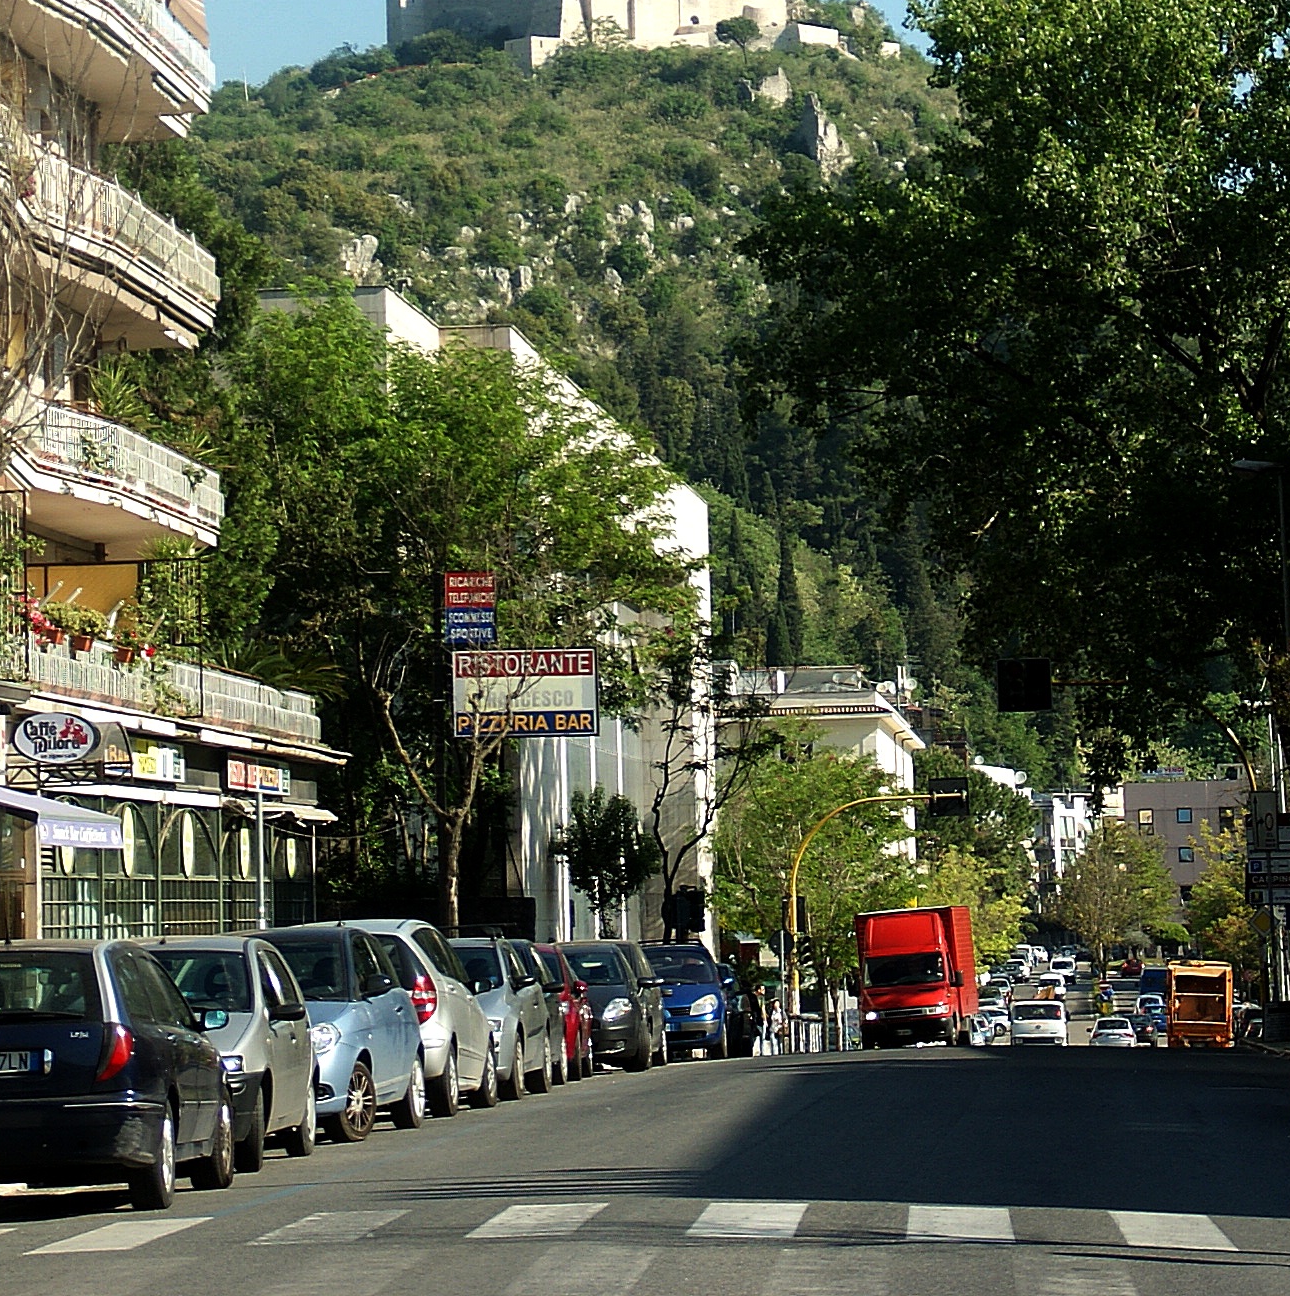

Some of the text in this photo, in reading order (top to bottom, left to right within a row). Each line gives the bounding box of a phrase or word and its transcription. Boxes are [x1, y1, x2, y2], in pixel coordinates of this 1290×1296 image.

[456, 653, 590, 675] RISTORANTE
[456, 714, 591, 732] PZZERIA BAR
